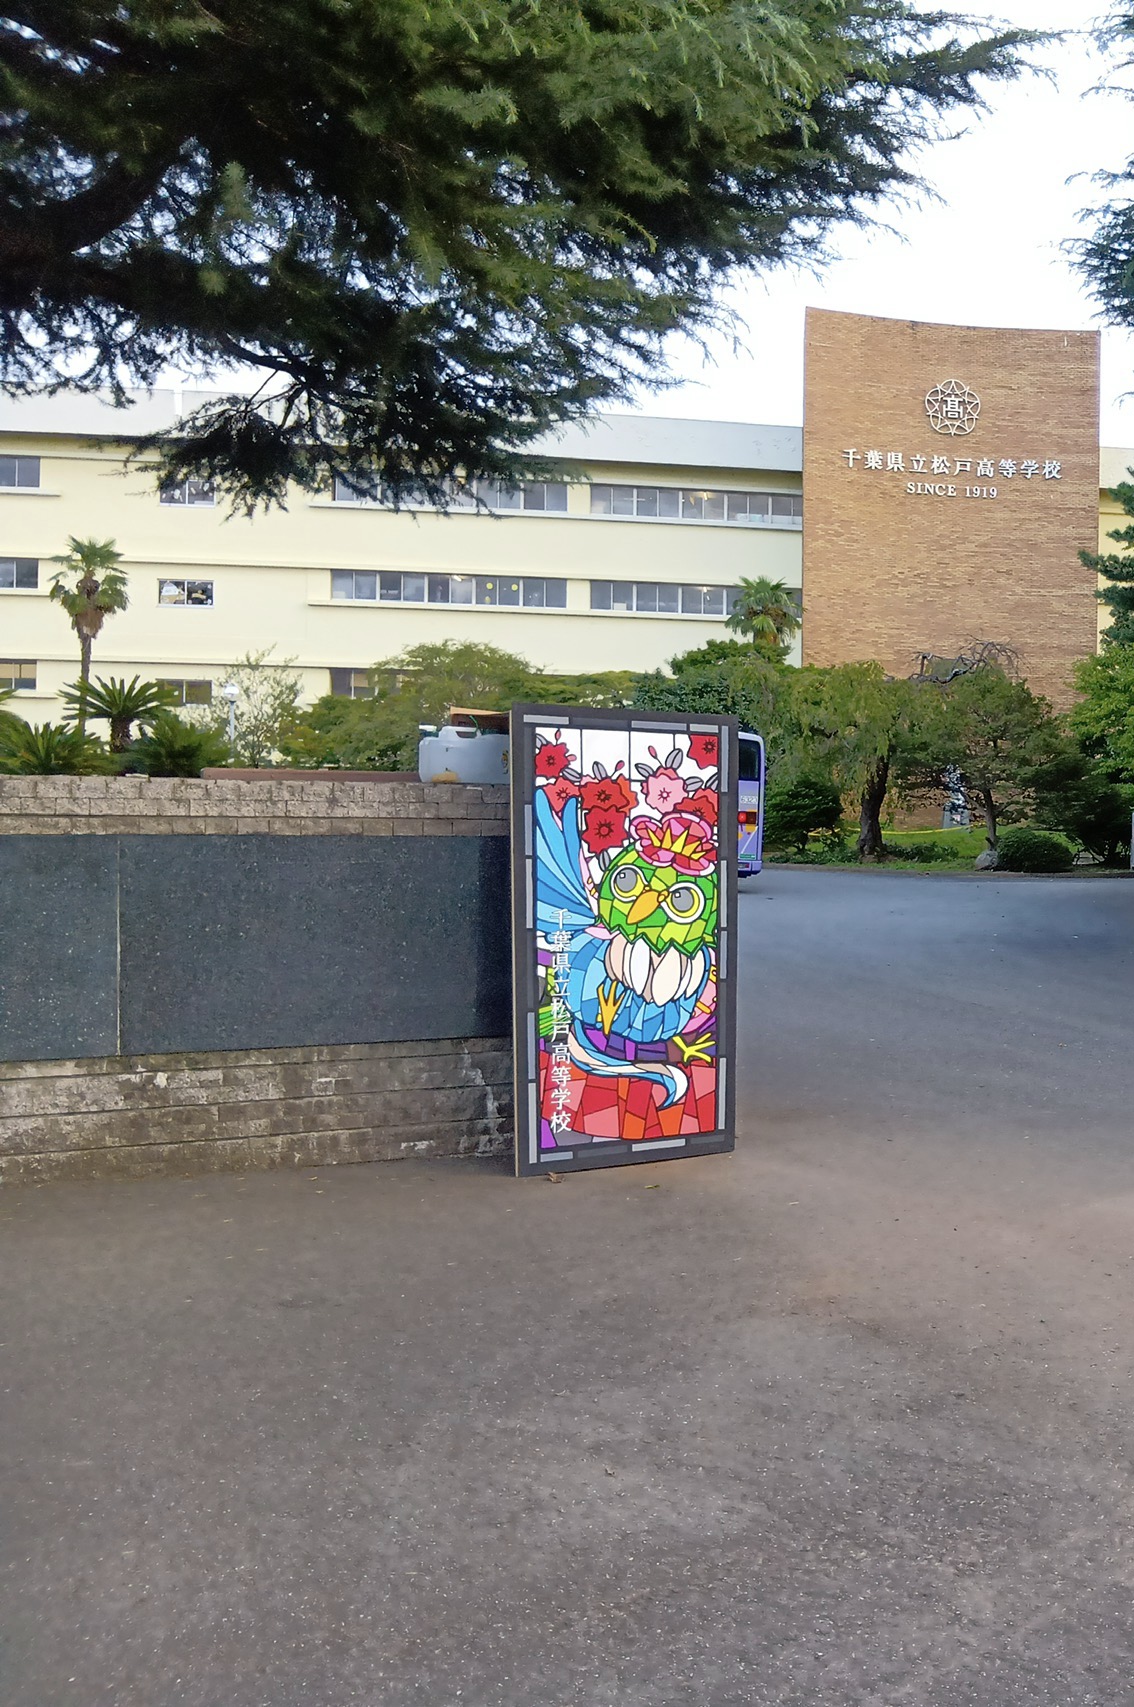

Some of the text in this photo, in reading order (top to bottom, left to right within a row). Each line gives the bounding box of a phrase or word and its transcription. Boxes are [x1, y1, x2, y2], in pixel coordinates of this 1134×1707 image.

[906, 482, 998, 499] SINCE 1919
[550, 908, 572, 1133] 千葉県立松戸高等学校
